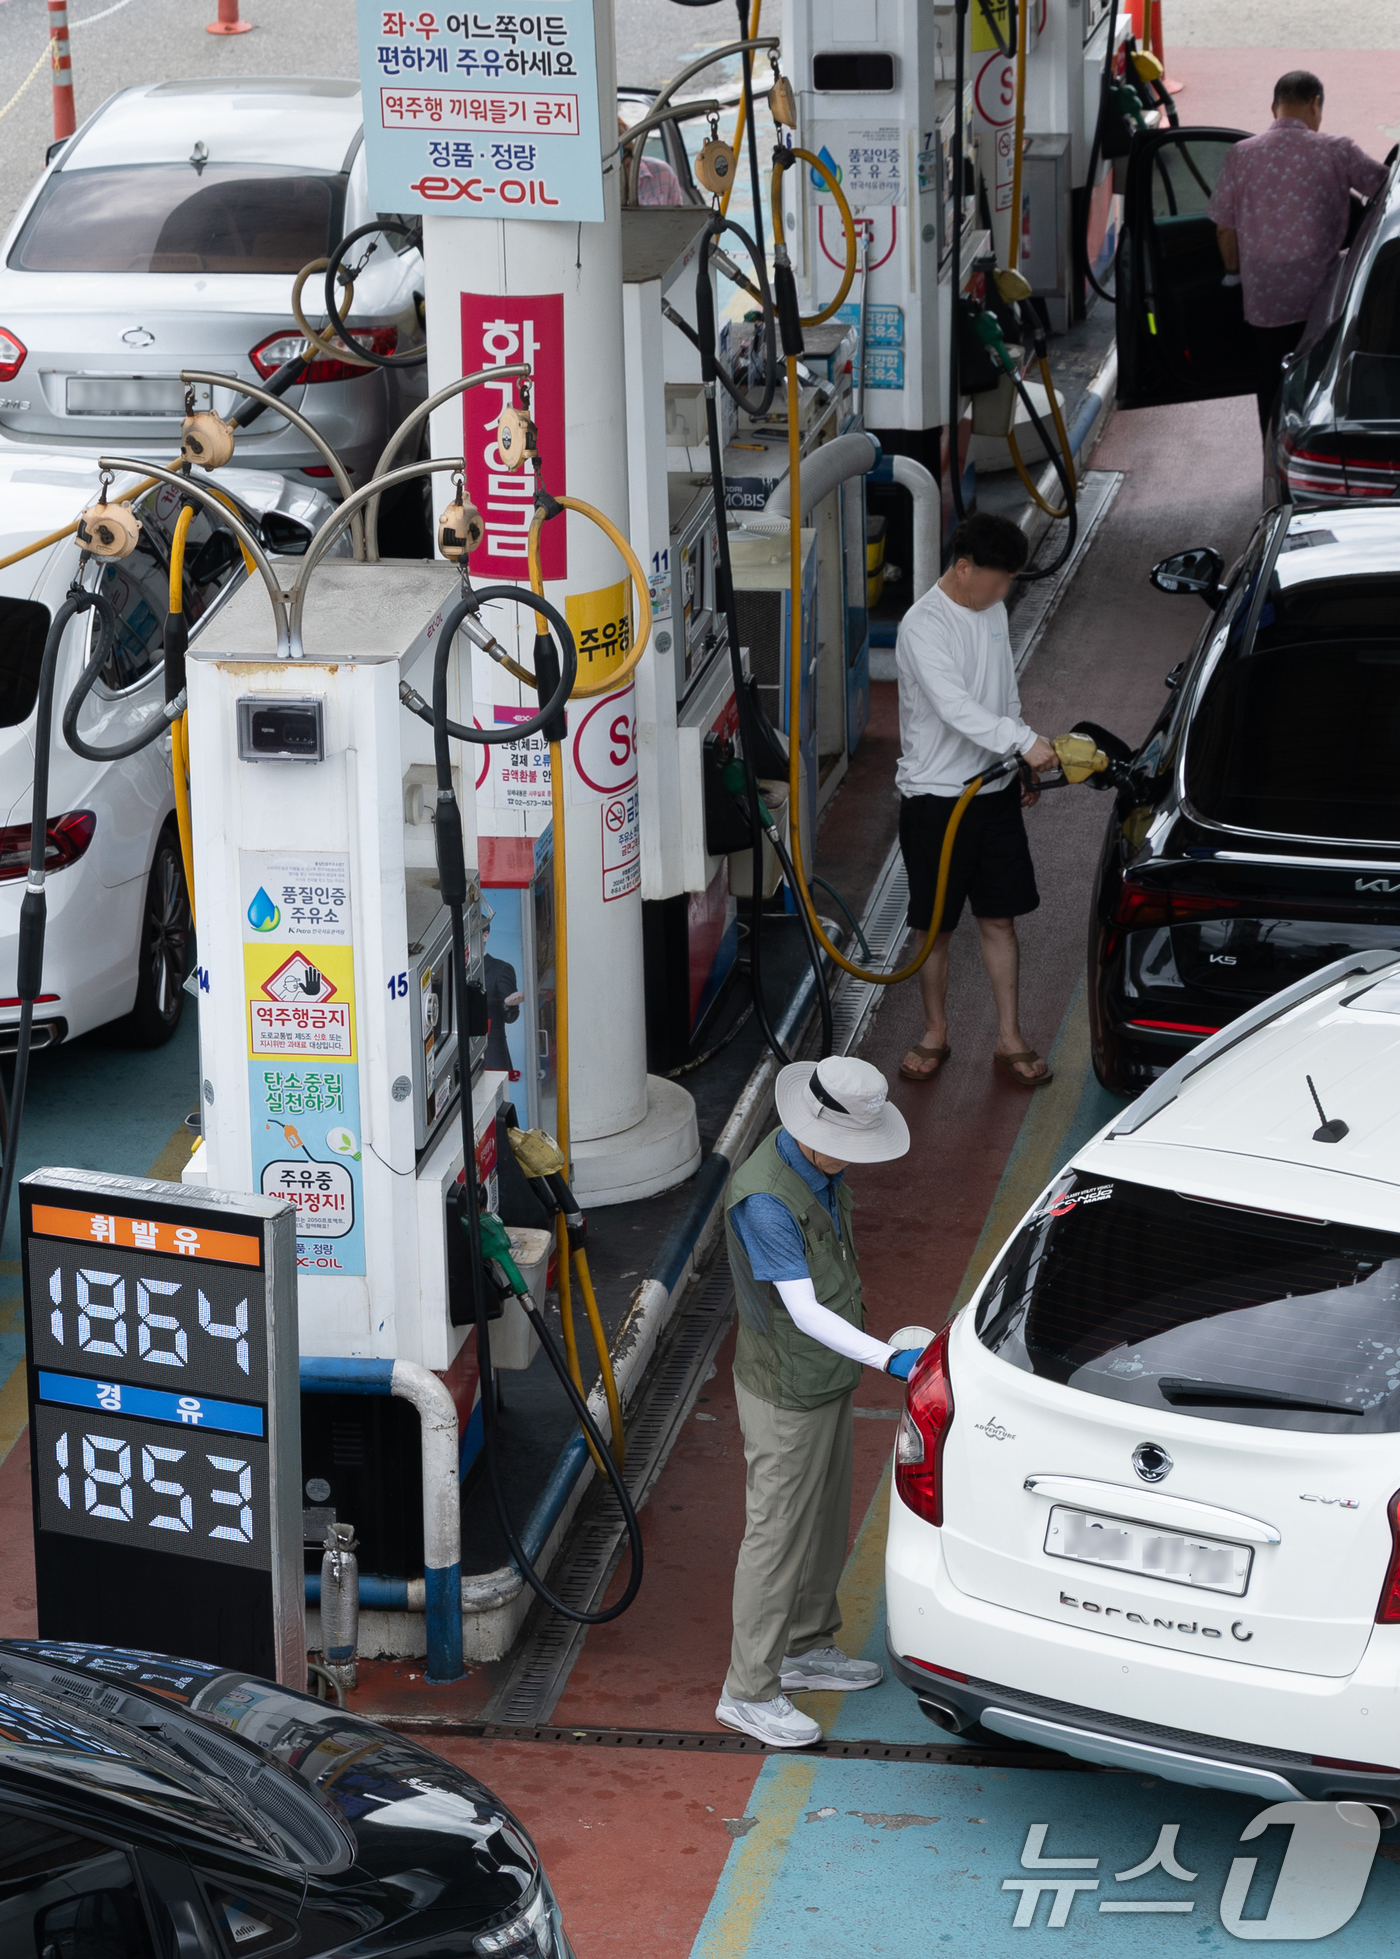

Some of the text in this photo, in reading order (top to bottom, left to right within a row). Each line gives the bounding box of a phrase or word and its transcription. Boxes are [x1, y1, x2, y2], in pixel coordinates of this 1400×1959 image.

[382, 12, 568, 46] 좌·우 어느쪽이든
[377, 45, 577, 77] 편하게 주유하세요
[385, 96, 572, 126] 역주행 끼워들기 금지
[786, 132, 792, 149] 6
[924, 132, 933, 150] 7
[849, 148, 900, 163] 품질인증
[652, 549, 669, 573] 11
[579, 614, 630, 662] 주유중
[281, 886, 347, 906] 품질인증
[290, 907, 340, 925] 주유소
[1209, 954, 1237, 966] K5
[387, 971, 409, 1001] 15
[256, 1007, 345, 1029] 역주행금지
[263, 1071, 342, 1094] 탄소중립
[265, 1092, 343, 1113] 실천하기
[280, 1170, 333, 1191] 주유중
[49, 1267, 250, 1376] 1864
[974, 1423, 1017, 1440] ADVENTURE
[55, 1432, 253, 1544] 1853
